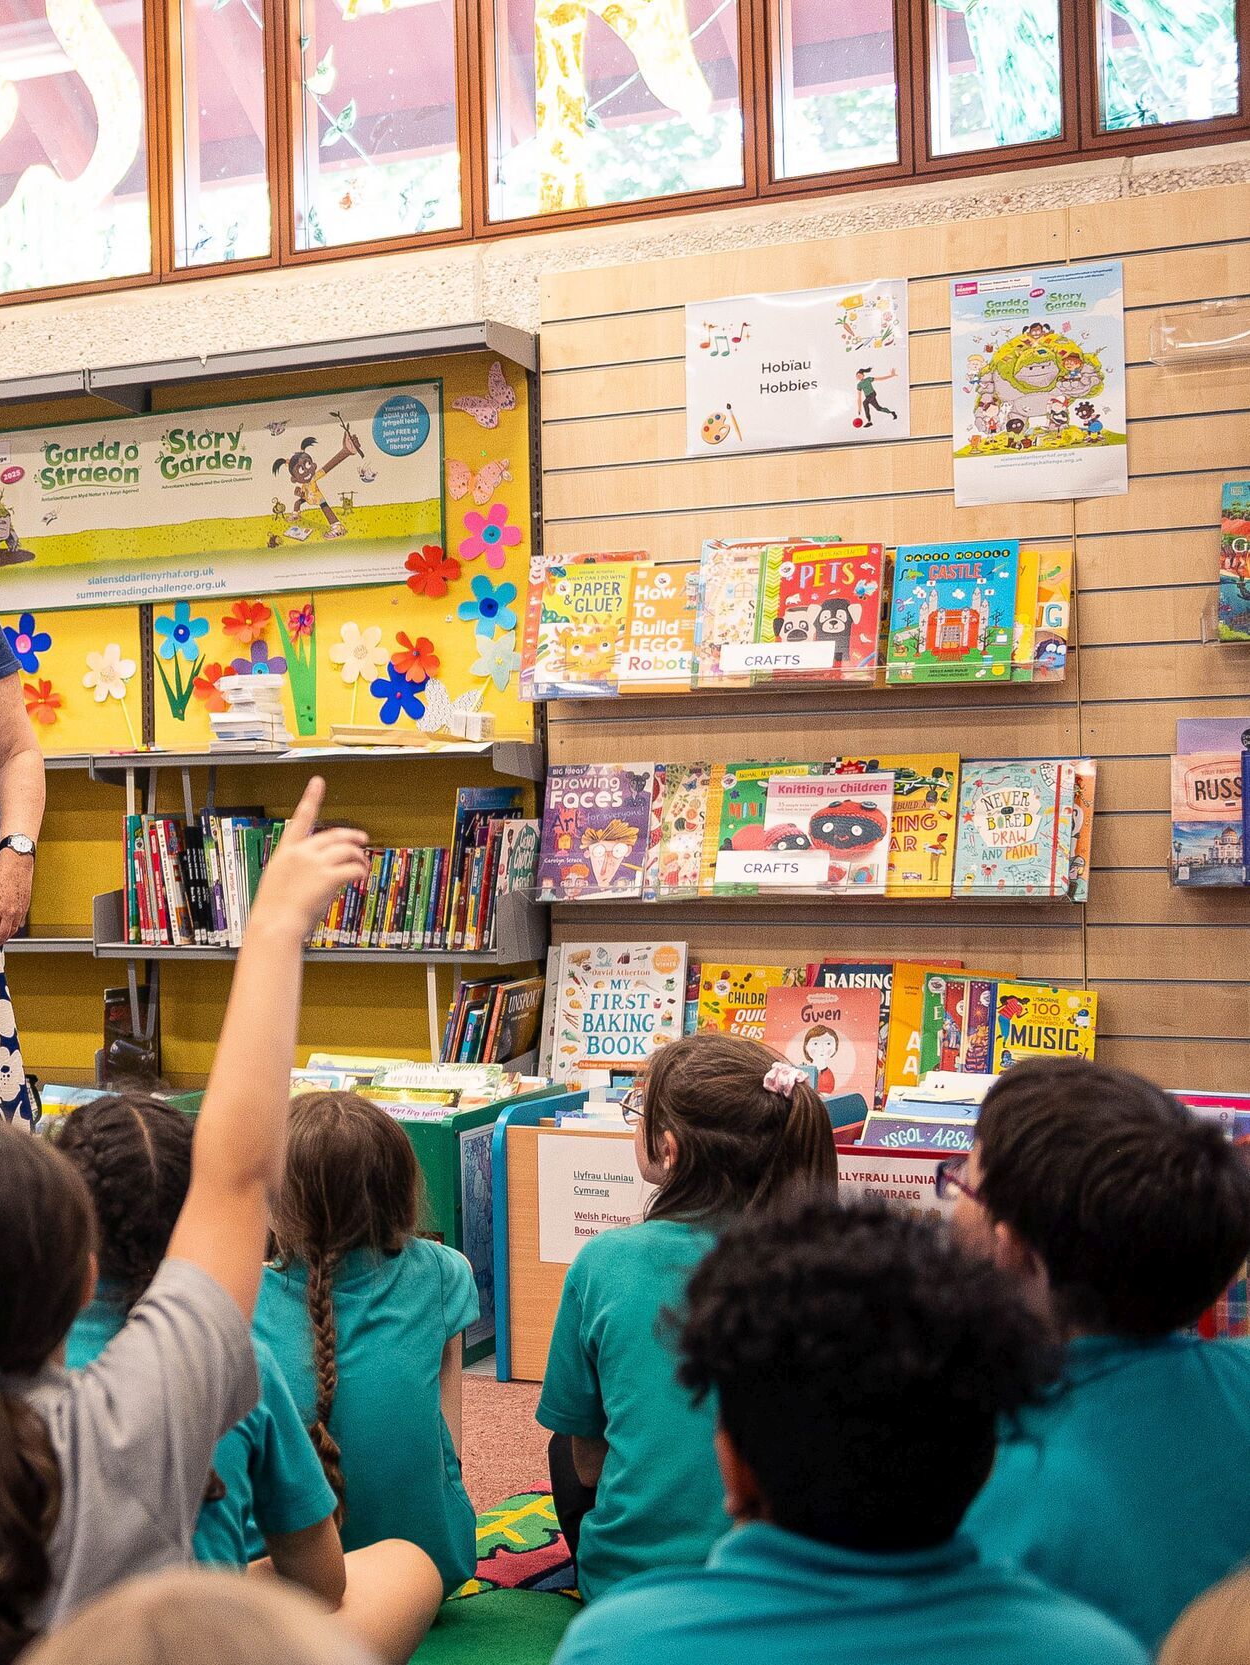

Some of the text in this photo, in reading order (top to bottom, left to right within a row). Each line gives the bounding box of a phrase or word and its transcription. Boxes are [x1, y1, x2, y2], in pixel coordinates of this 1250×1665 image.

[761, 359, 812, 374] Hobïau
[760, 379, 818, 394] Hobbies
[168, 427, 242, 454] Story
[44, 440, 139, 466] Gardd o
[160, 451, 252, 480] Garden
[2, 470, 21, 480] 2025
[40, 466, 140, 490] Straeon
[904, 550, 1010, 562] MAKER MODELS
[800, 562, 855, 589] PETS
[928, 563, 982, 580] CASTLE
[76, 580, 226, 600] summerreadingchallenge.org.uk
[573, 582, 620, 597] PAPER
[634, 586, 676, 600] How
[564, 595, 573, 606] &
[574, 597, 622, 613] GLUE?
[633, 602, 656, 618] To
[631, 619, 680, 636] Build
[629, 638, 684, 652] LEGO
[744, 655, 800, 666] CRAFTS
[551, 776, 621, 792] Drawing
[778, 783, 824, 796] Knitting
[840, 782, 887, 793] Children
[1194, 778, 1242, 801] RUSS
[550, 790, 623, 809] Faces
[982, 791, 1030, 812] NEVER
[552, 810, 583, 830] Art
[987, 812, 1032, 830] BORED
[889, 836, 917, 852] AR
[992, 831, 1026, 845] DRAW
[982, 844, 1039, 861] AND PAINT
[744, 862, 799, 873] CRAFTS
[610, 980, 631, 990] MY
[824, 973, 892, 989] RAISING
[590, 994, 650, 1010] FIRST
[728, 992, 767, 1005] CHILDR
[735, 1009, 766, 1023] QUIC
[801, 1005, 841, 1023] Gwen
[1032, 1003, 1060, 1016] 100
[582, 1013, 654, 1032] BAKING
[730, 1024, 765, 1040] & EAS
[1010, 1024, 1079, 1051] MUSIC
[586, 1036, 647, 1055] BOOK
[879, 1128, 974, 1151] YSGOL ARSW
[574, 1170, 634, 1182] Llyfrau Lluniau
[838, 1172, 936, 1184] LLYFRAU LLUNIA
[574, 1186, 610, 1196] Cymraeg
[864, 1188, 920, 1200] CYMRAEG
[574, 1211, 631, 1224] Welsh Picture
[574, 1226, 599, 1236] Books
